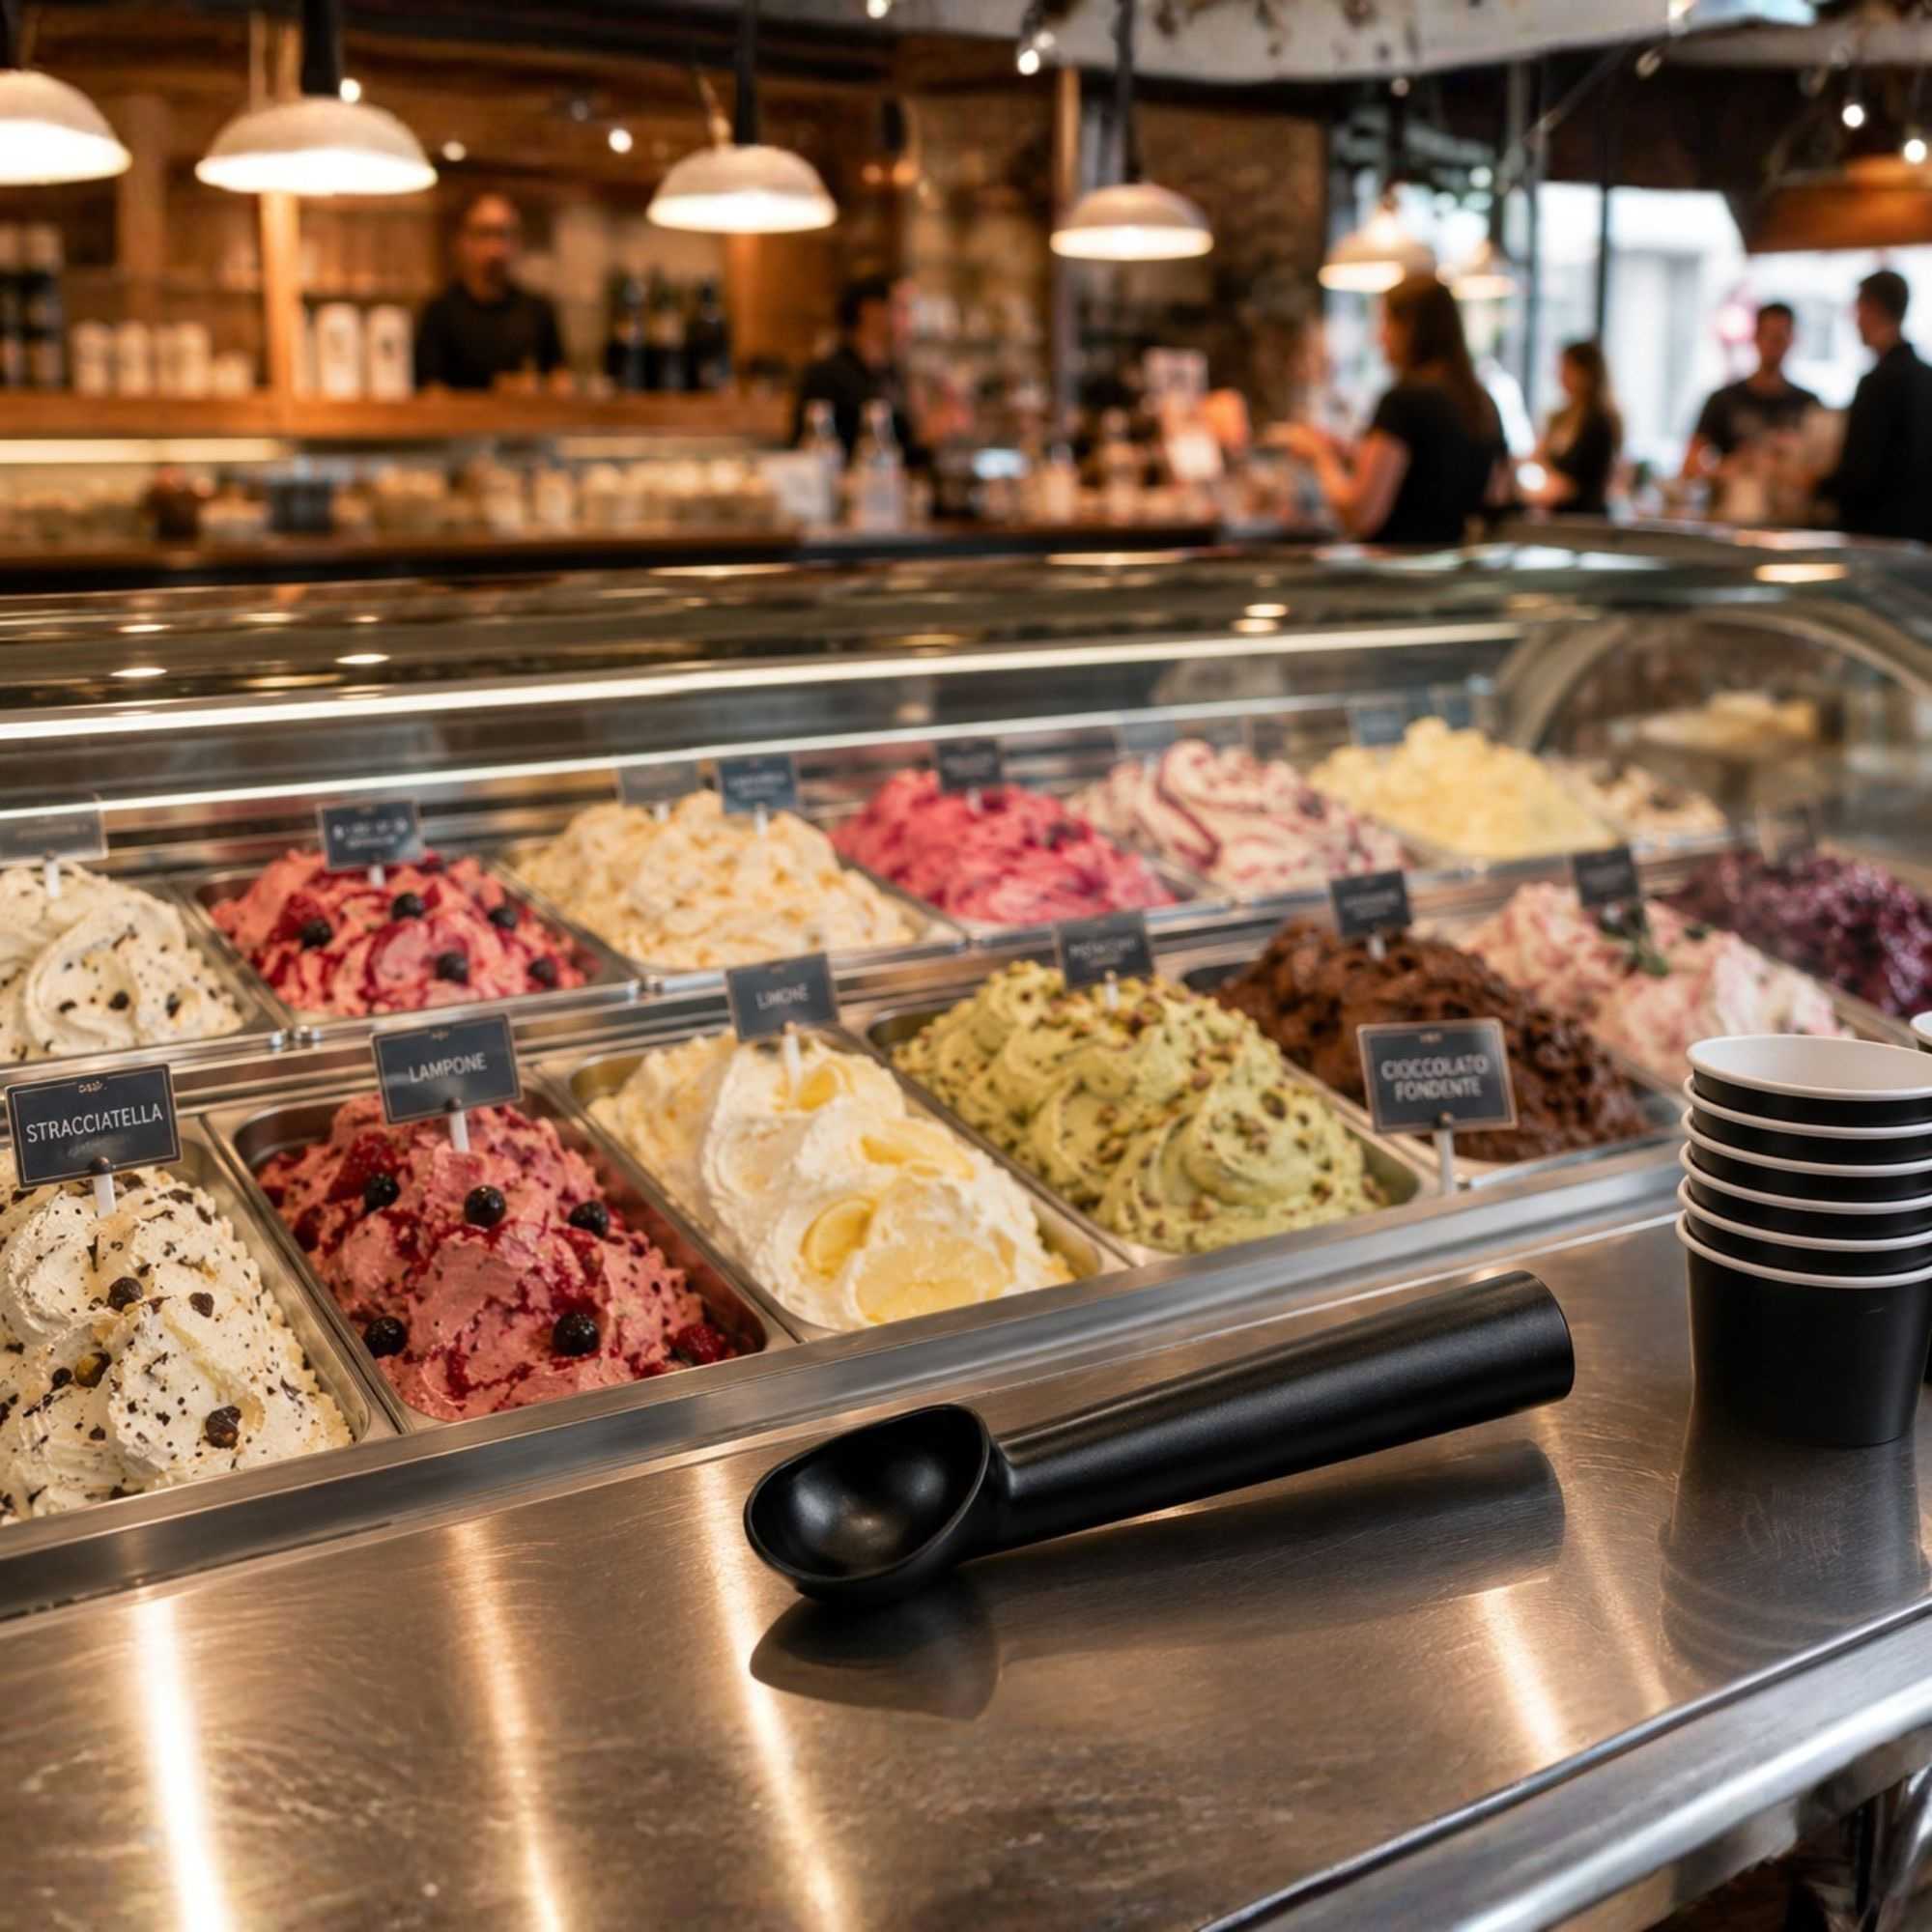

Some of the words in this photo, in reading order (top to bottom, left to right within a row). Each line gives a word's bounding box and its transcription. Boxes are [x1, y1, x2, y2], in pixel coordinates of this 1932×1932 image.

[409, 1052, 488, 1083] LAMPONE
[1380, 1054, 1489, 1081] CIOCCOLATO
[1394, 1076, 1483, 1101] FONDENTE
[26, 1103, 163, 1143] STRACCIATELLA
